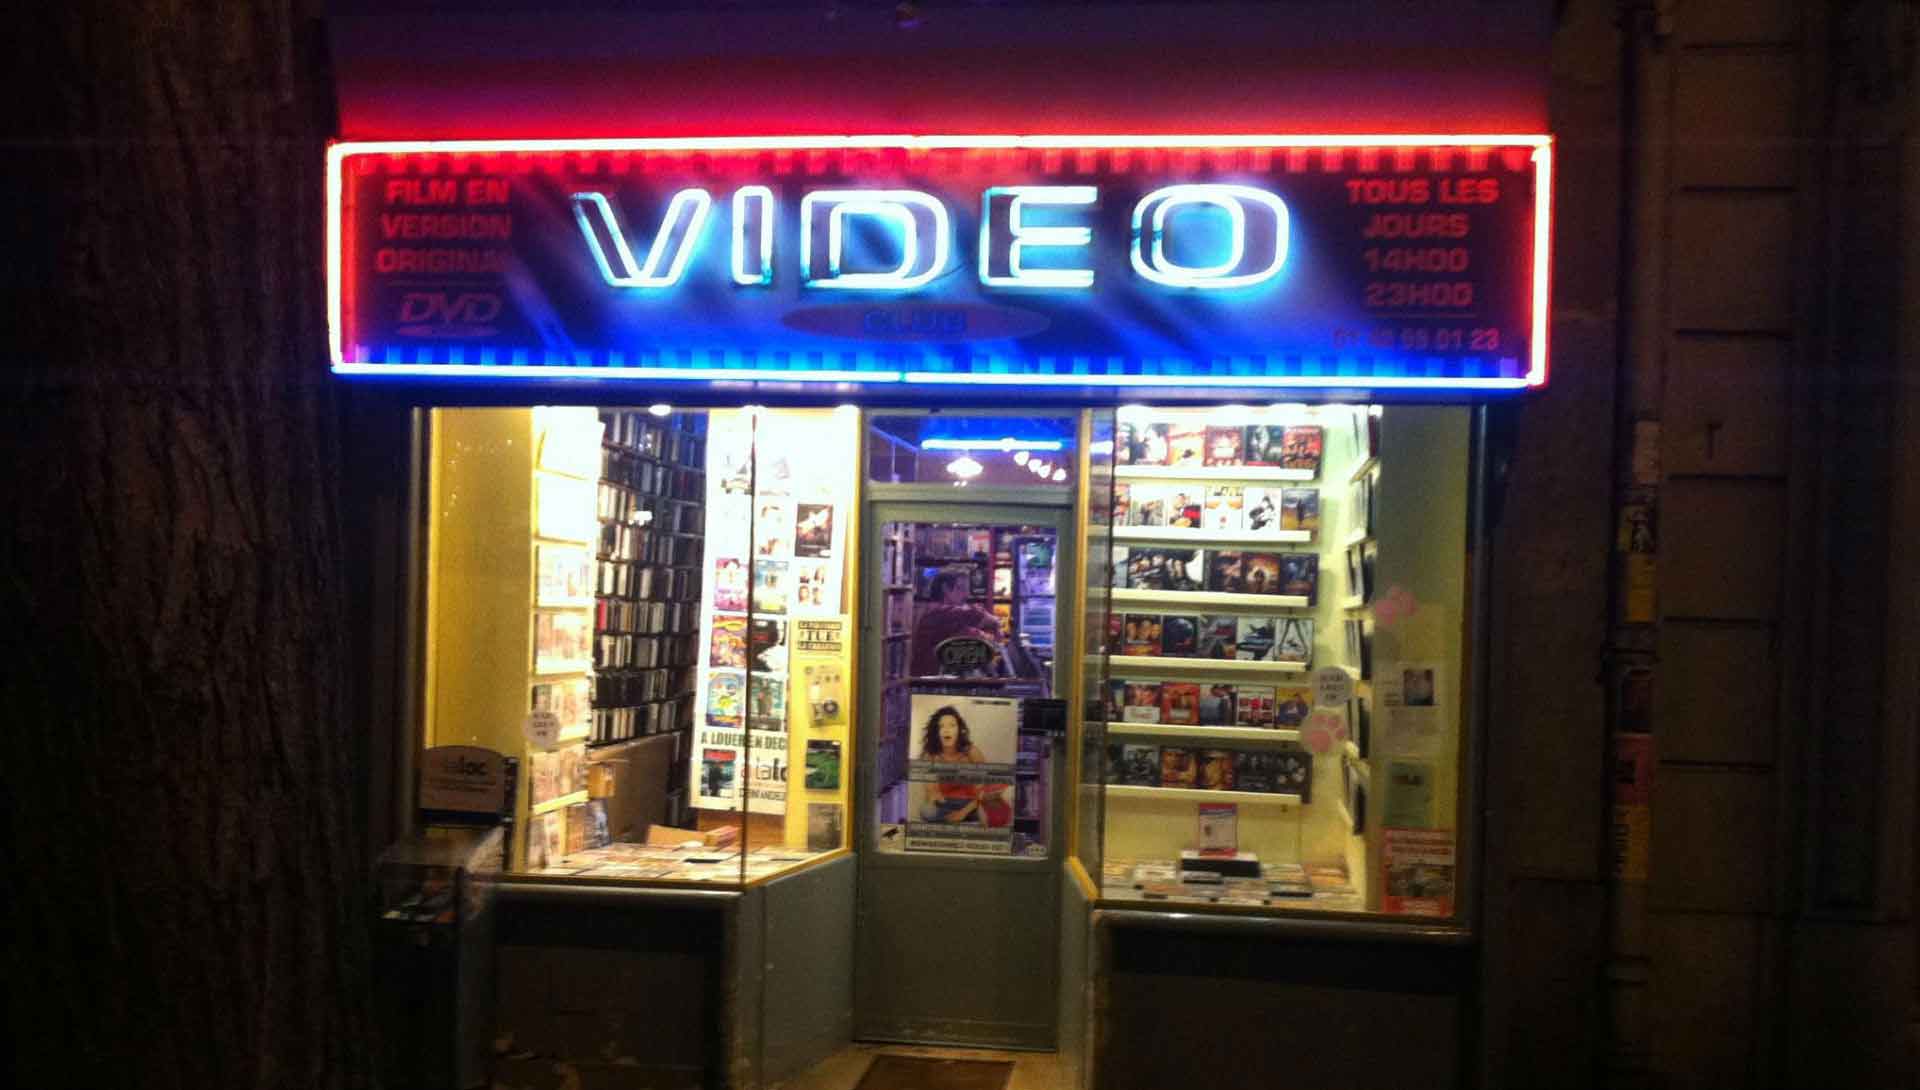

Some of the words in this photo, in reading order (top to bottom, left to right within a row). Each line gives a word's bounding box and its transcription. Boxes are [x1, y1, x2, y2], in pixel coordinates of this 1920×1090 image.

[386, 179, 457, 205] FILM
[466, 179, 511, 205] EN
[1345, 178, 1431, 205] TOUS
[1439, 177, 1499, 205] LES
[381, 213, 512, 240] VERSION
[572, 184, 1290, 289] VIDEO
[1362, 212, 1471, 240] JOURS
[376, 248, 519, 273] ORIGINA
[1363, 247, 1470, 273] 14H00
[400, 292, 501, 323] DVD
[1366, 281, 1473, 308] 23H00
[1470, 327, 1500, 351] 23
